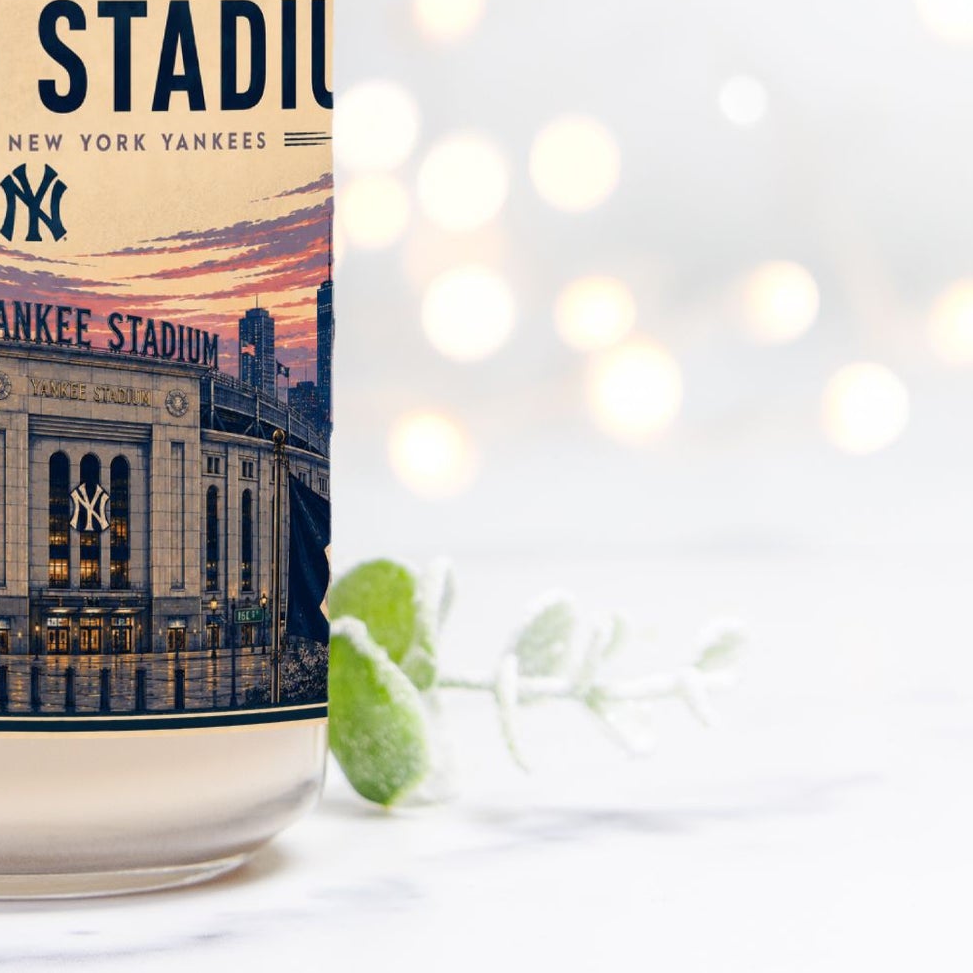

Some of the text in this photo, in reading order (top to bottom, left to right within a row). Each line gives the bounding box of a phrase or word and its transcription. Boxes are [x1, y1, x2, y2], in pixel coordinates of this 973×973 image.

[8, 133, 63, 152] NEW
[79, 133, 146, 152] YORK
[161, 131, 266, 151] YANKEES
[107, 311, 220, 370] STADIUM
[30, 378, 152, 407] YANKEE STADIUM
